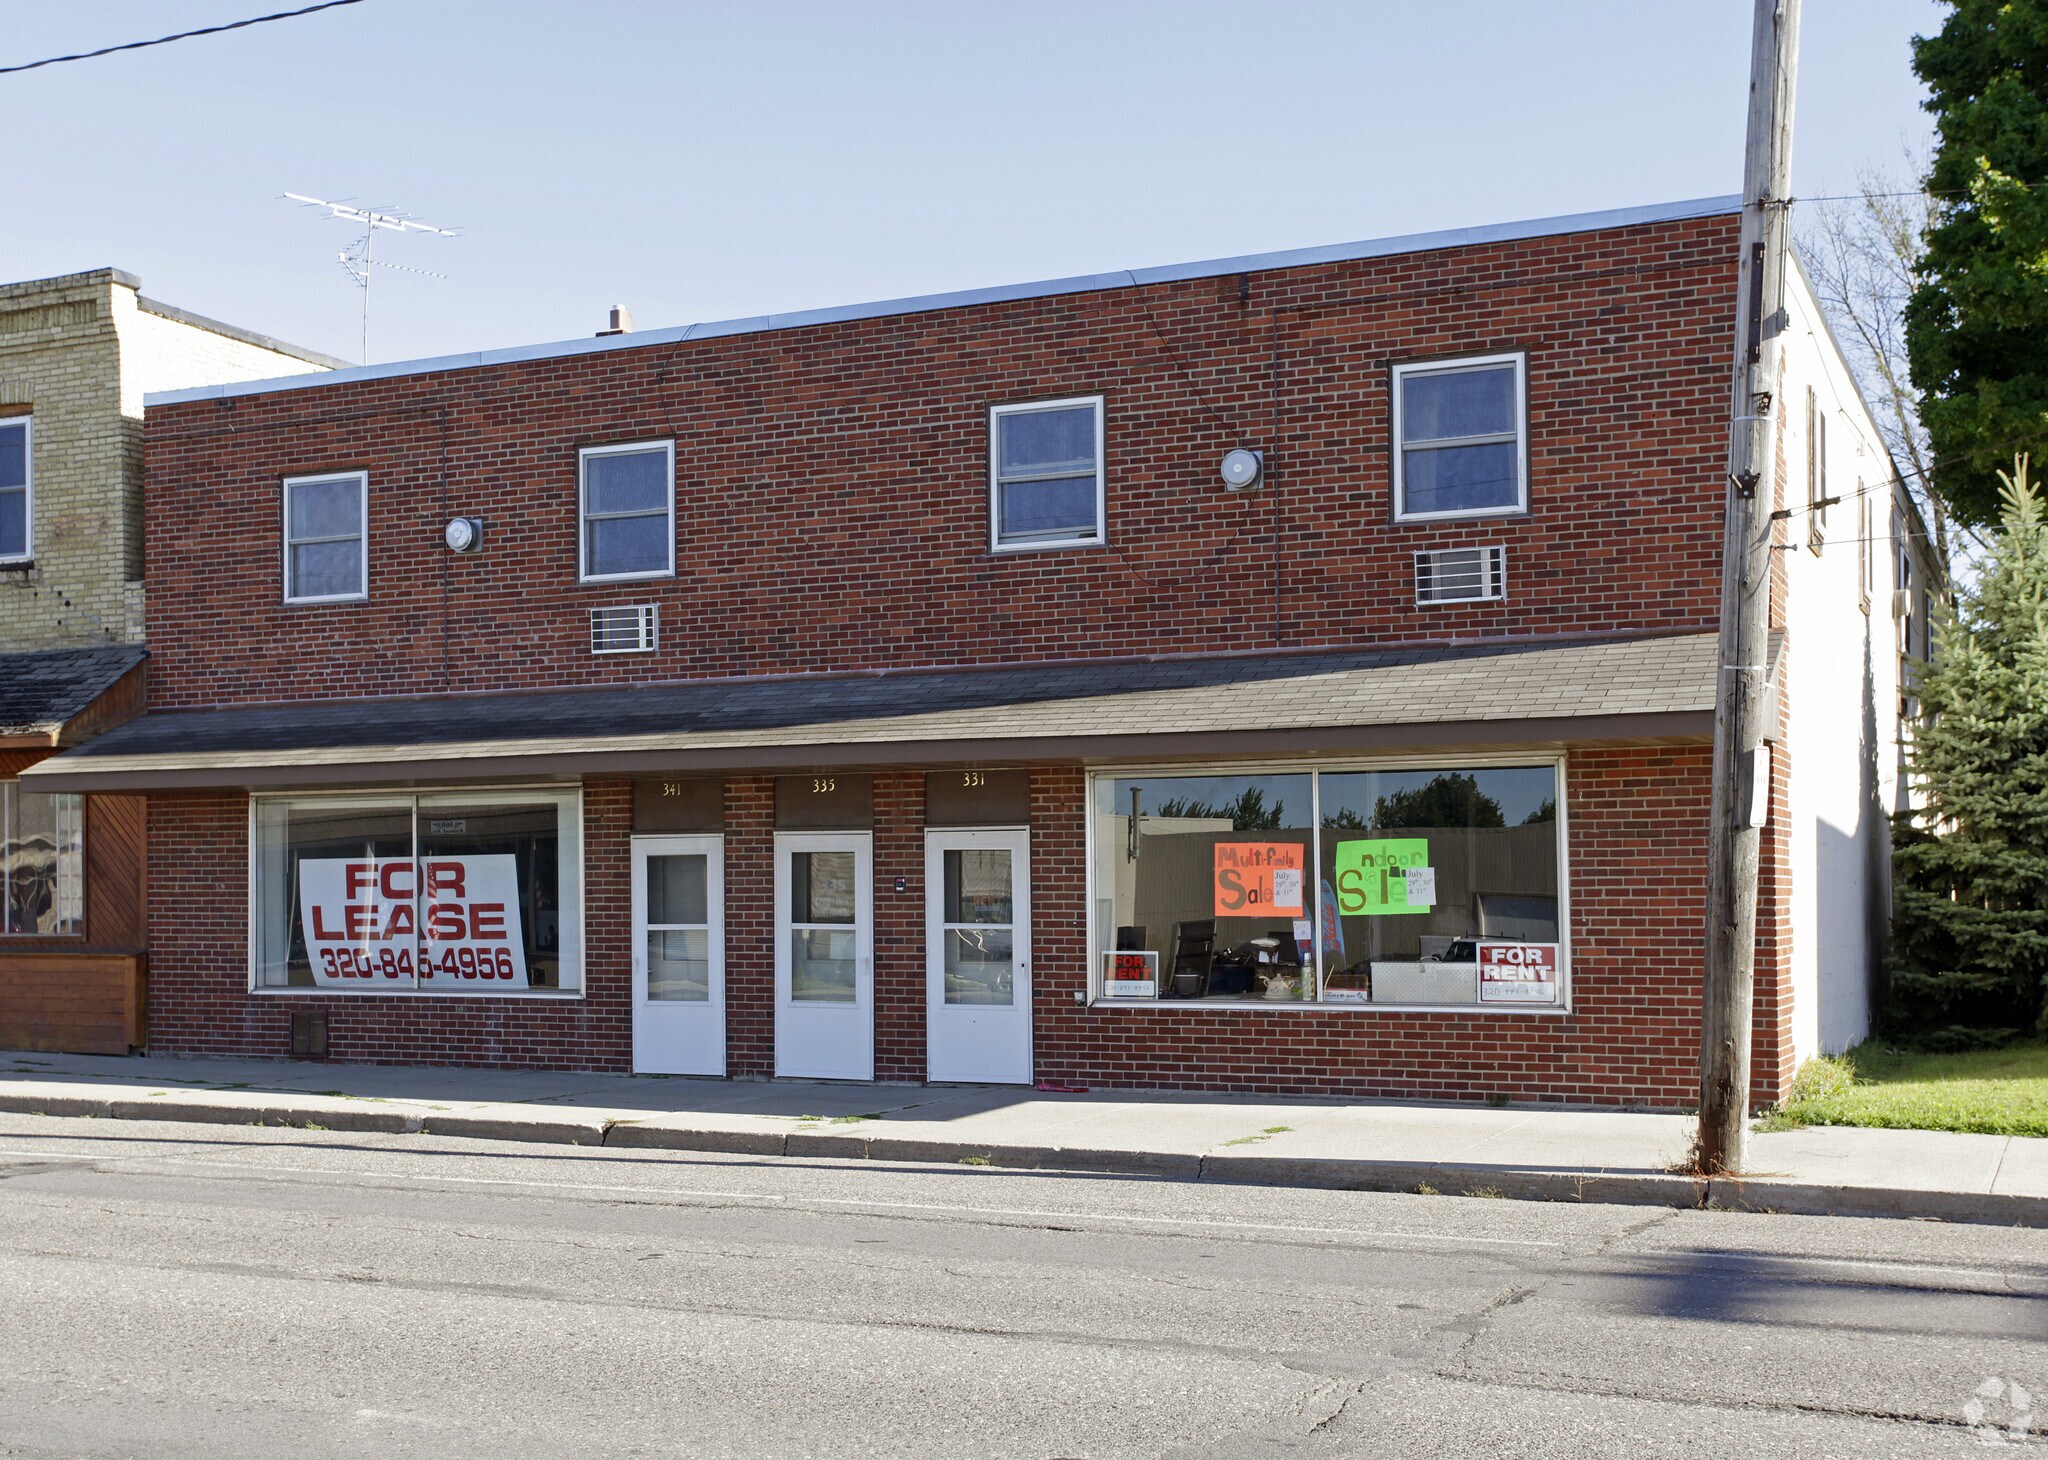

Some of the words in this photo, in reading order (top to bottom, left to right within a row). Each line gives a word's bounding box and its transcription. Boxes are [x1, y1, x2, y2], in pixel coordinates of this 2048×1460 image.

[812, 778, 835, 793] 335
[963, 772, 985, 787] 331
[662, 783, 681, 796] 341
[345, 861, 466, 900] FOR
[1275, 871, 1290, 881] July
[1407, 869, 1424, 879] July
[1219, 868, 1273, 911] Sale
[1338, 869, 1407, 912] Sale
[312, 903, 507, 941] LEASE
[1114, 955, 1144, 968] FOR
[1491, 948, 1543, 964] FOR
[1107, 967, 1152, 980] RENT
[1483, 964, 1552, 980] RENT
